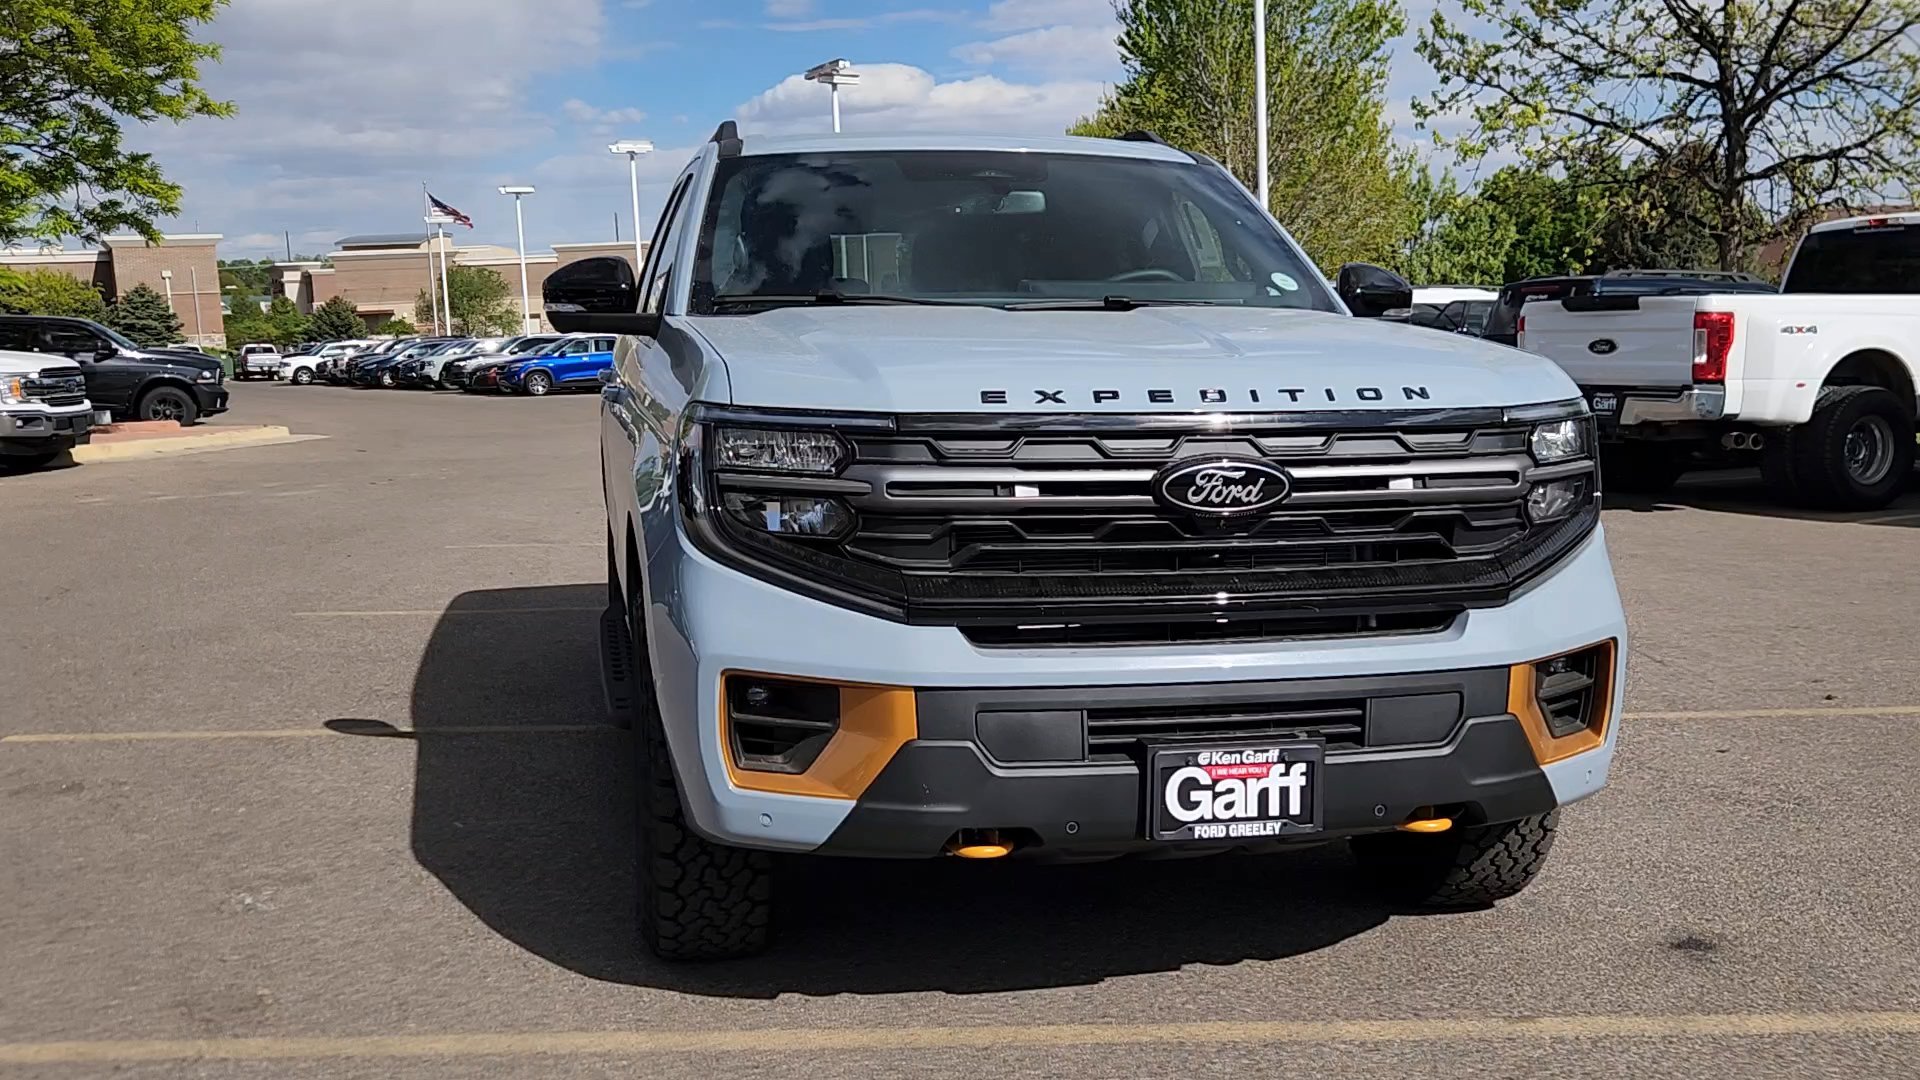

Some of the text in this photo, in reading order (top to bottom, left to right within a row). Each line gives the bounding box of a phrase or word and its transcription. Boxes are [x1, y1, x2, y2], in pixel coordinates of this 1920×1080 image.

[980, 386, 1430, 405] EXPEDITION
[1187, 469, 1265, 503] Ford
[1211, 749, 1280, 765] Ken Garff
[1229, 767, 1248, 776] HEAR
[1248, 766, 1262, 775] YOU
[1165, 762, 1307, 822] Garff
[1194, 821, 1282, 838] FORD GREELEY
